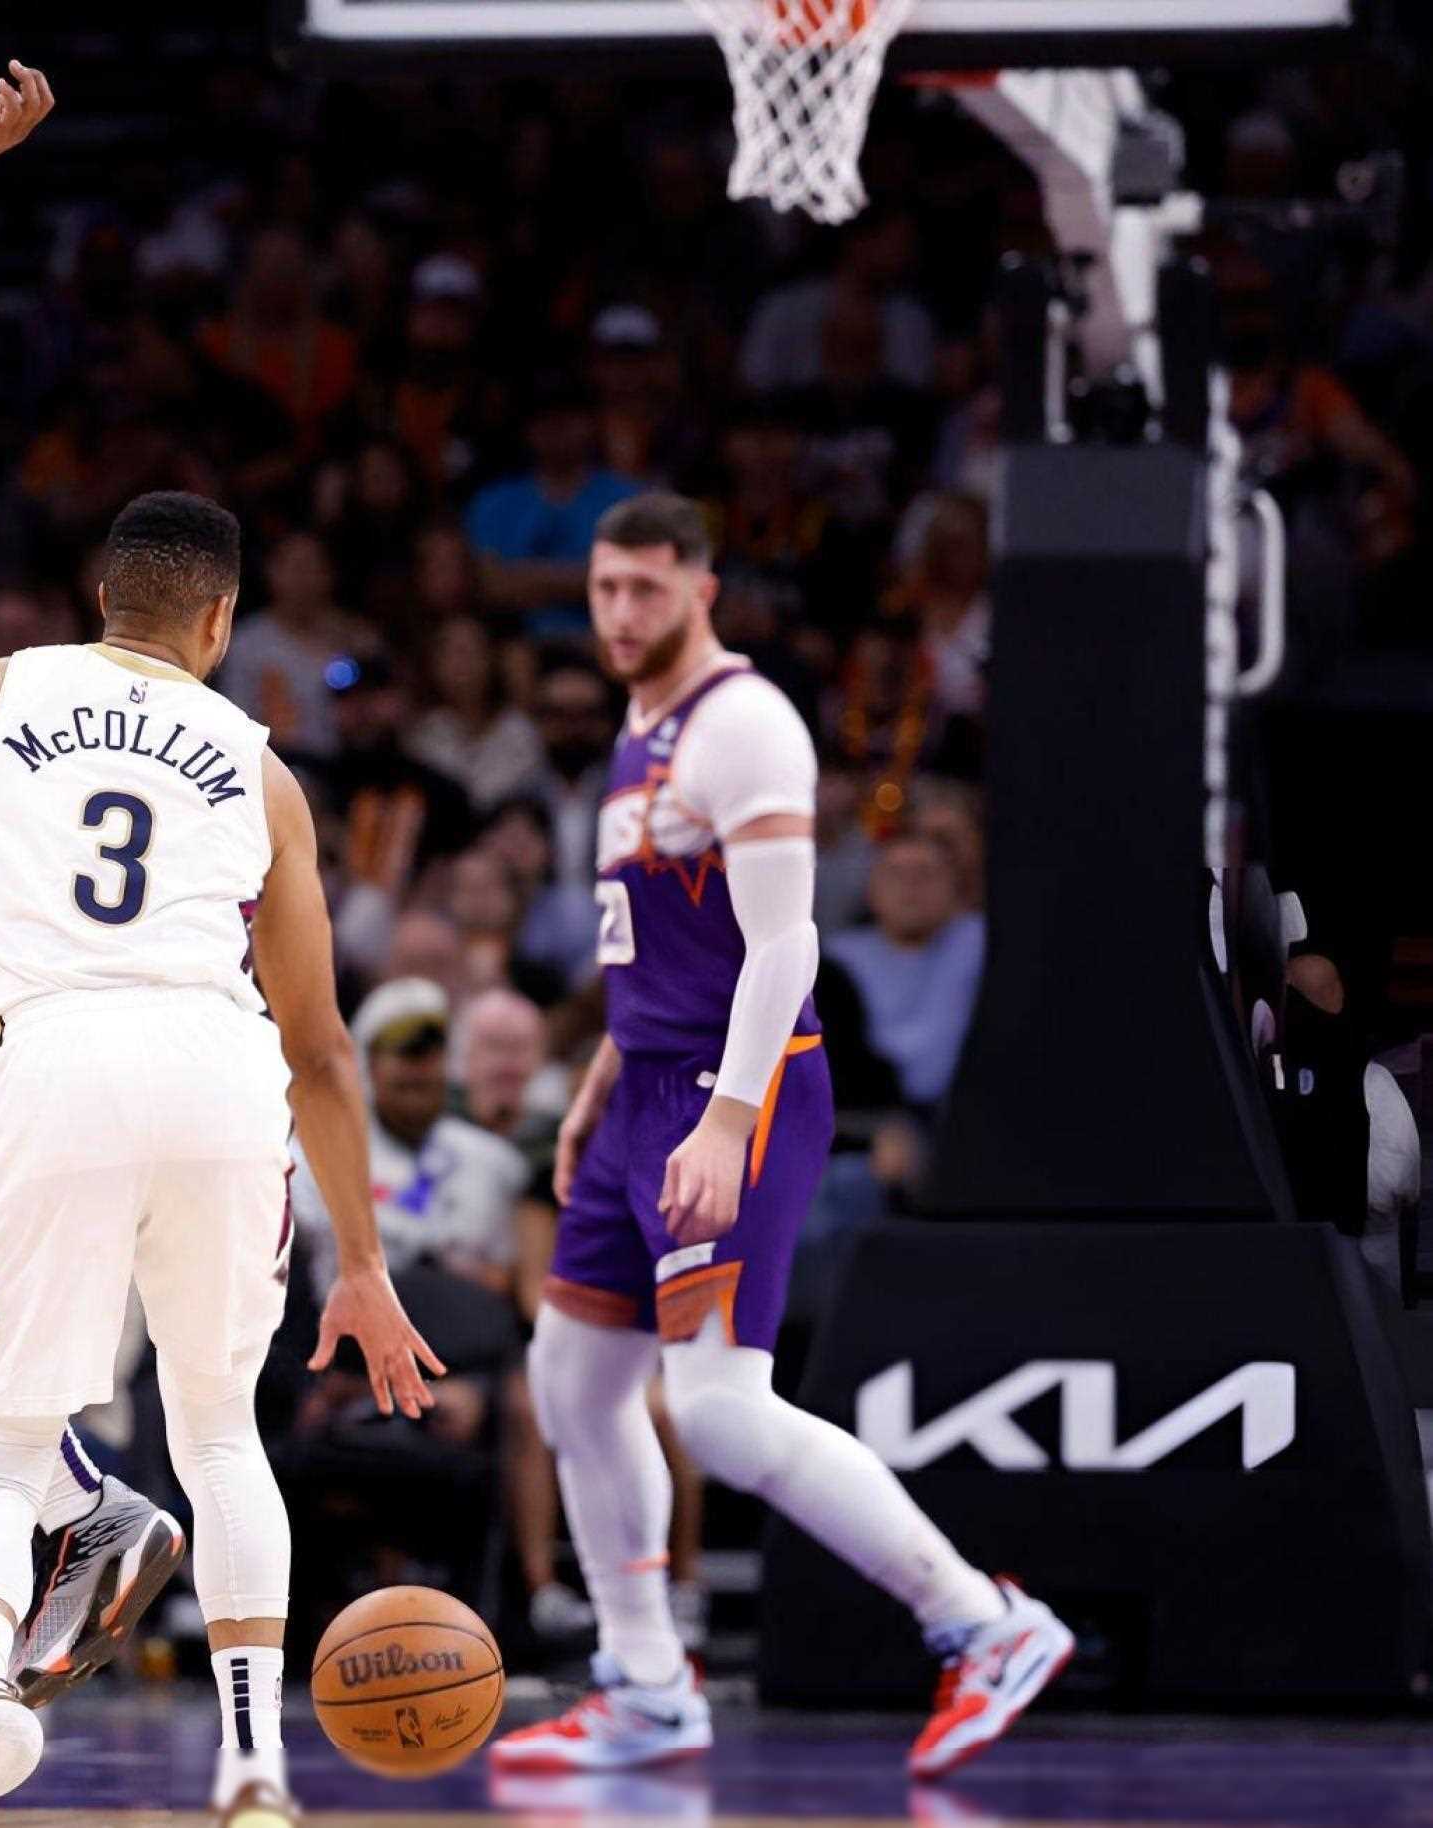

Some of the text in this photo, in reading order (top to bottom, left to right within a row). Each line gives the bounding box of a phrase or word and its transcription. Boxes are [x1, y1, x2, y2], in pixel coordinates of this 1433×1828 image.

[2, 706, 246, 807] McCOLLUM
[72, 789, 154, 926] 3
[855, 1358, 1296, 1472] KIA
[337, 1642, 465, 1689] Wilson
